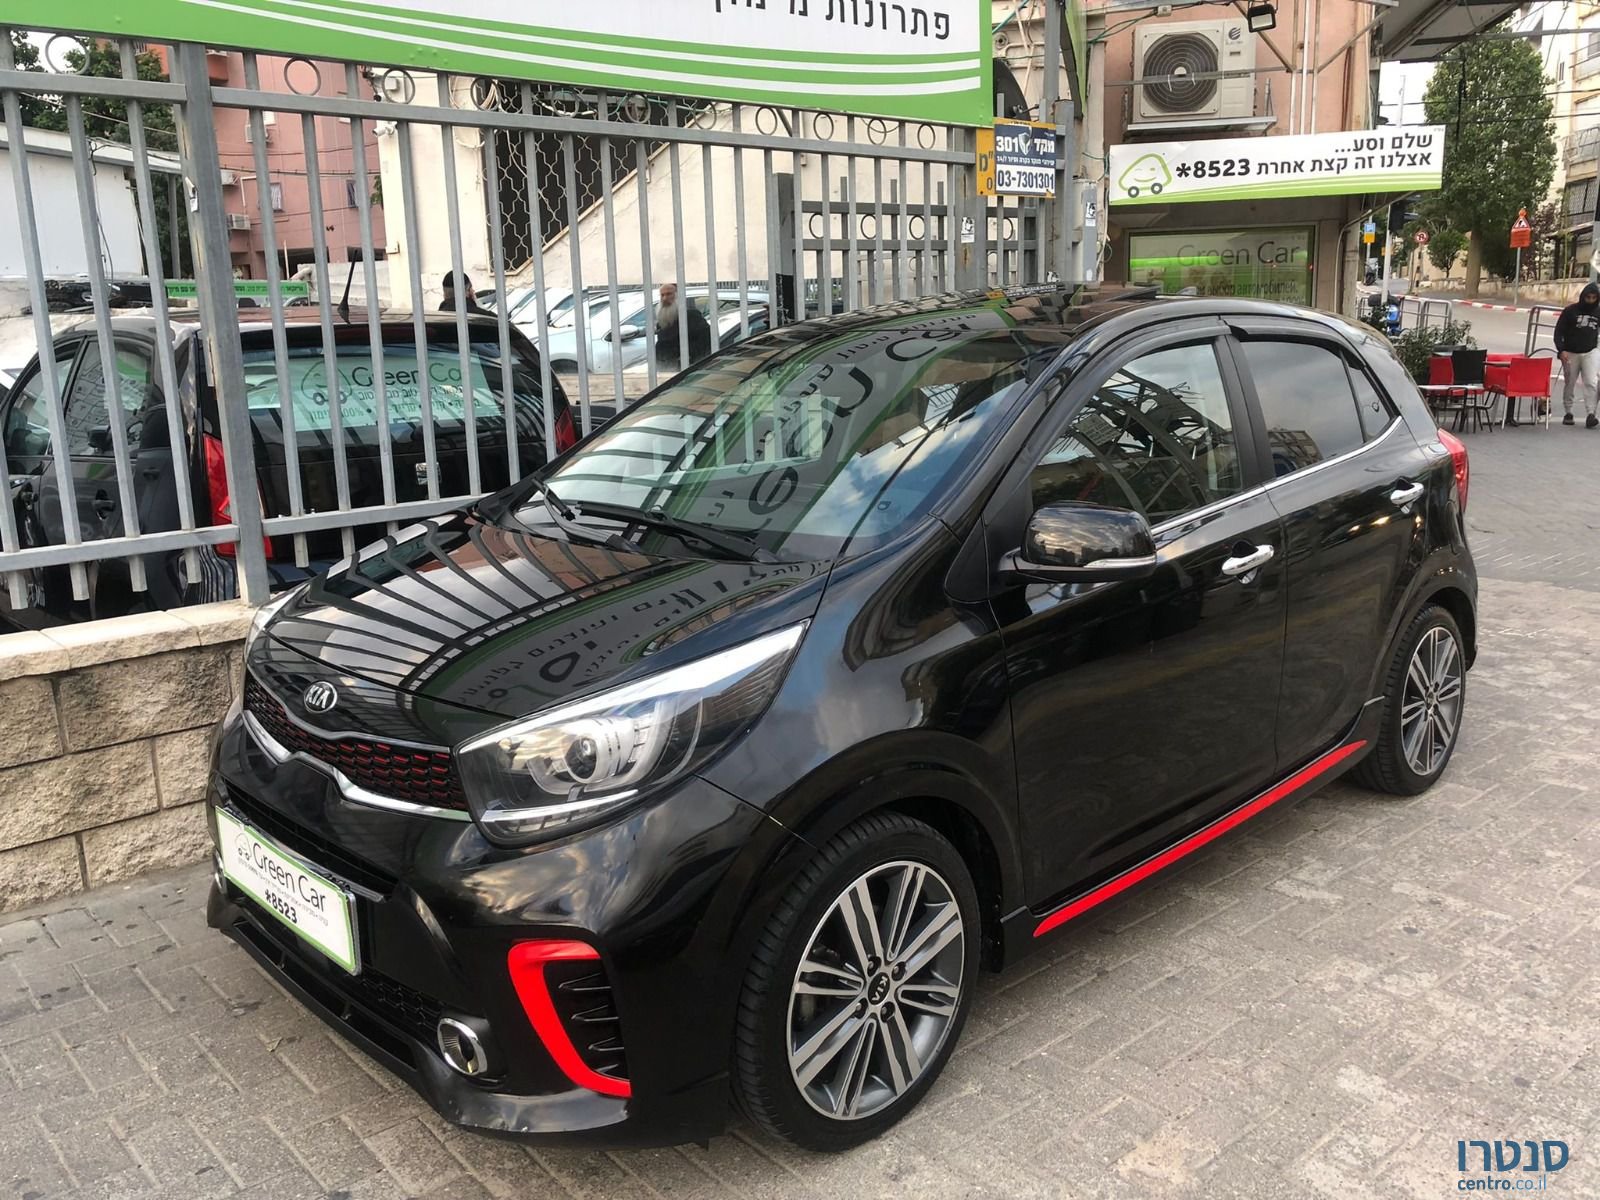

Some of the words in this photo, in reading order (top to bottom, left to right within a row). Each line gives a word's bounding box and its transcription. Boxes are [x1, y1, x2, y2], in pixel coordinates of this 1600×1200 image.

[825, 0, 950, 40] פתרונות
[996, 136, 1018, 153] 301
[1391, 132, 1433, 151] שלם
[1257, 159, 1305, 175] אחרת
[1310, 156, 1348, 175] קצת
[1354, 154, 1375, 170] זה
[1380, 151, 1432, 168] אצלנו
[997, 169, 1054, 190] 03-7301301
[1176, 244, 1250, 267] Green
[1257, 240, 1301, 264] Car
[429, 362, 463, 383] Ca
[305, 684, 331, 709] KIA
[252, 842, 296, 893] Green
[298, 875, 326, 912] Car
[871, 975, 889, 1001] KIA
